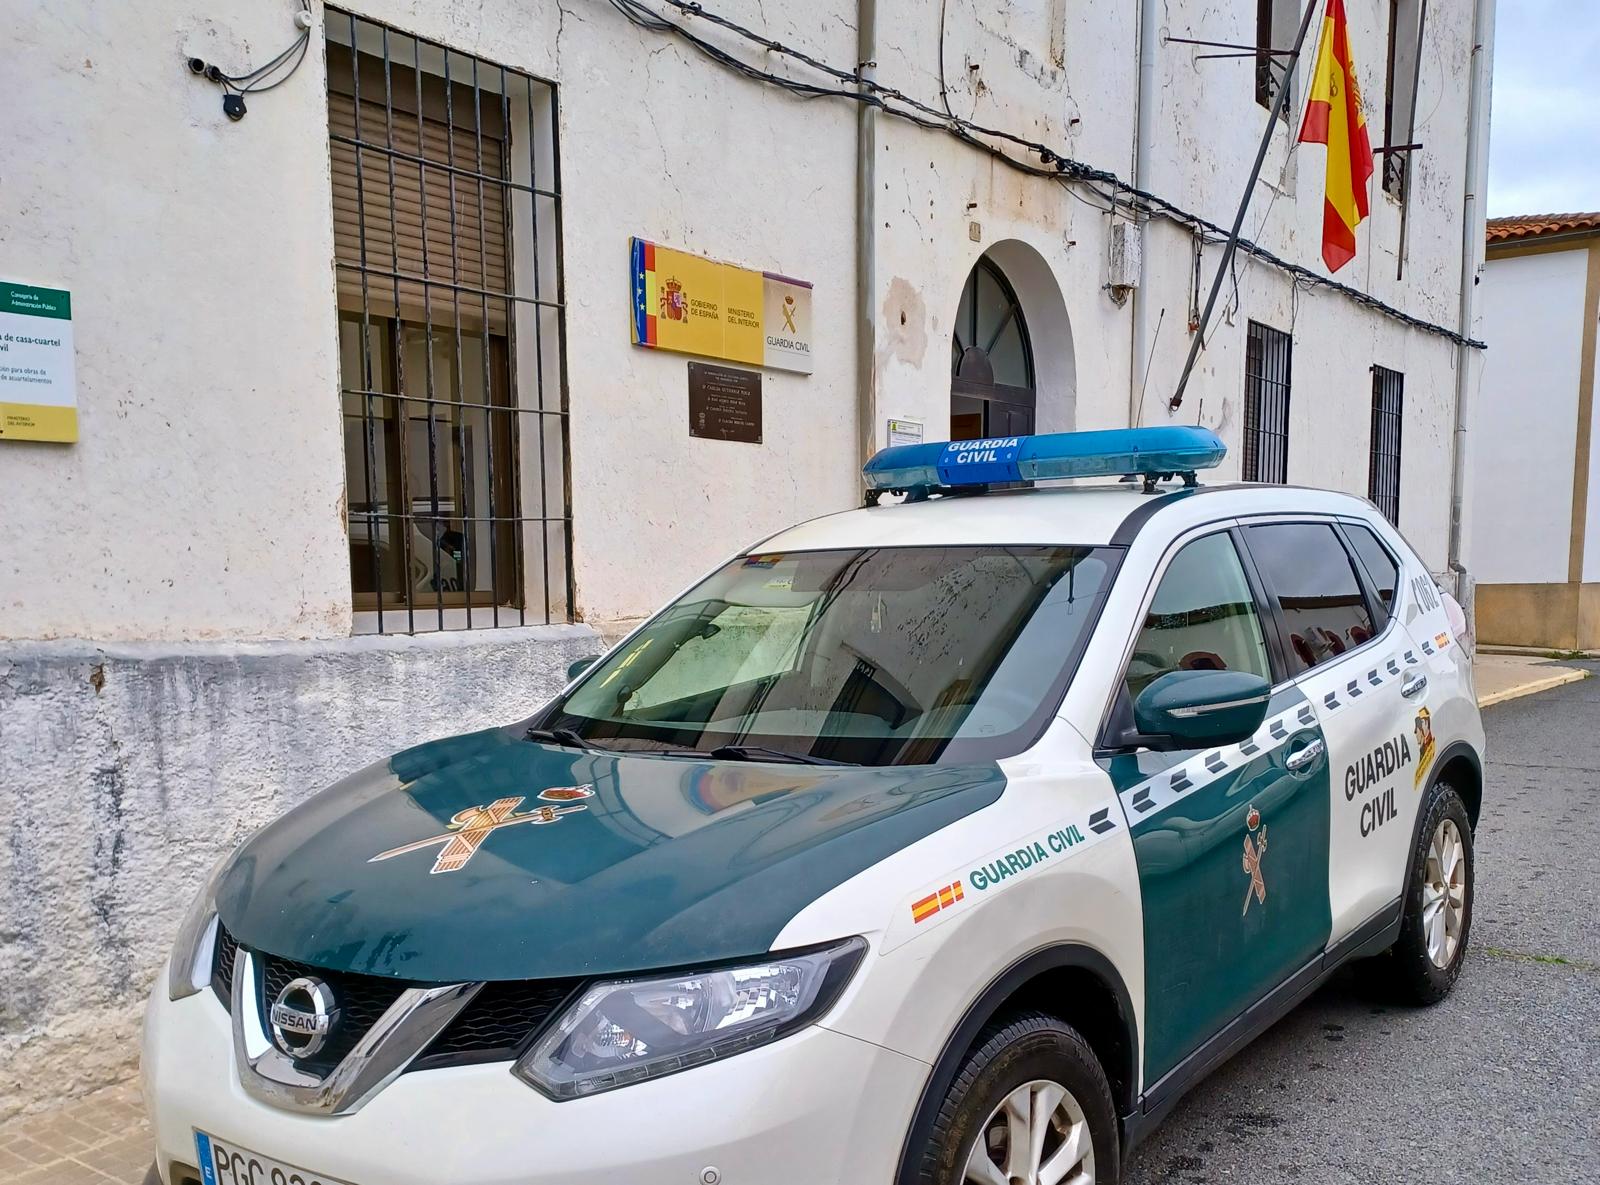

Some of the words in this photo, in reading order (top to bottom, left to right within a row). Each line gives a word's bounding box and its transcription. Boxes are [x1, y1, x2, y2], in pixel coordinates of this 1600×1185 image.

[690, 299, 718, 311] GOBIERNO
[690, 308, 698, 316] DE
[699, 309, 719, 320] ESPAÑA
[727, 308, 754, 319] MINISTERIO
[727, 316, 737, 324] DEL
[738, 317, 760, 328] INTERIOR
[4, 333, 14, 342] de
[16, 336, 60, 347] casa-cuartel
[766, 336, 794, 350] GUARDIA
[795, 342, 810, 352] CIVIL
[948, 438, 1018, 452] GUARDIA
[956, 450, 998, 464] CIVIL
[1345, 733, 1412, 801] GUARDIA
[1360, 787, 1398, 838] CIVIL
[970, 841, 1050, 890] GUARDIA
[1048, 824, 1086, 853] CIVIL
[272, 1009, 317, 1031] NISSAN
